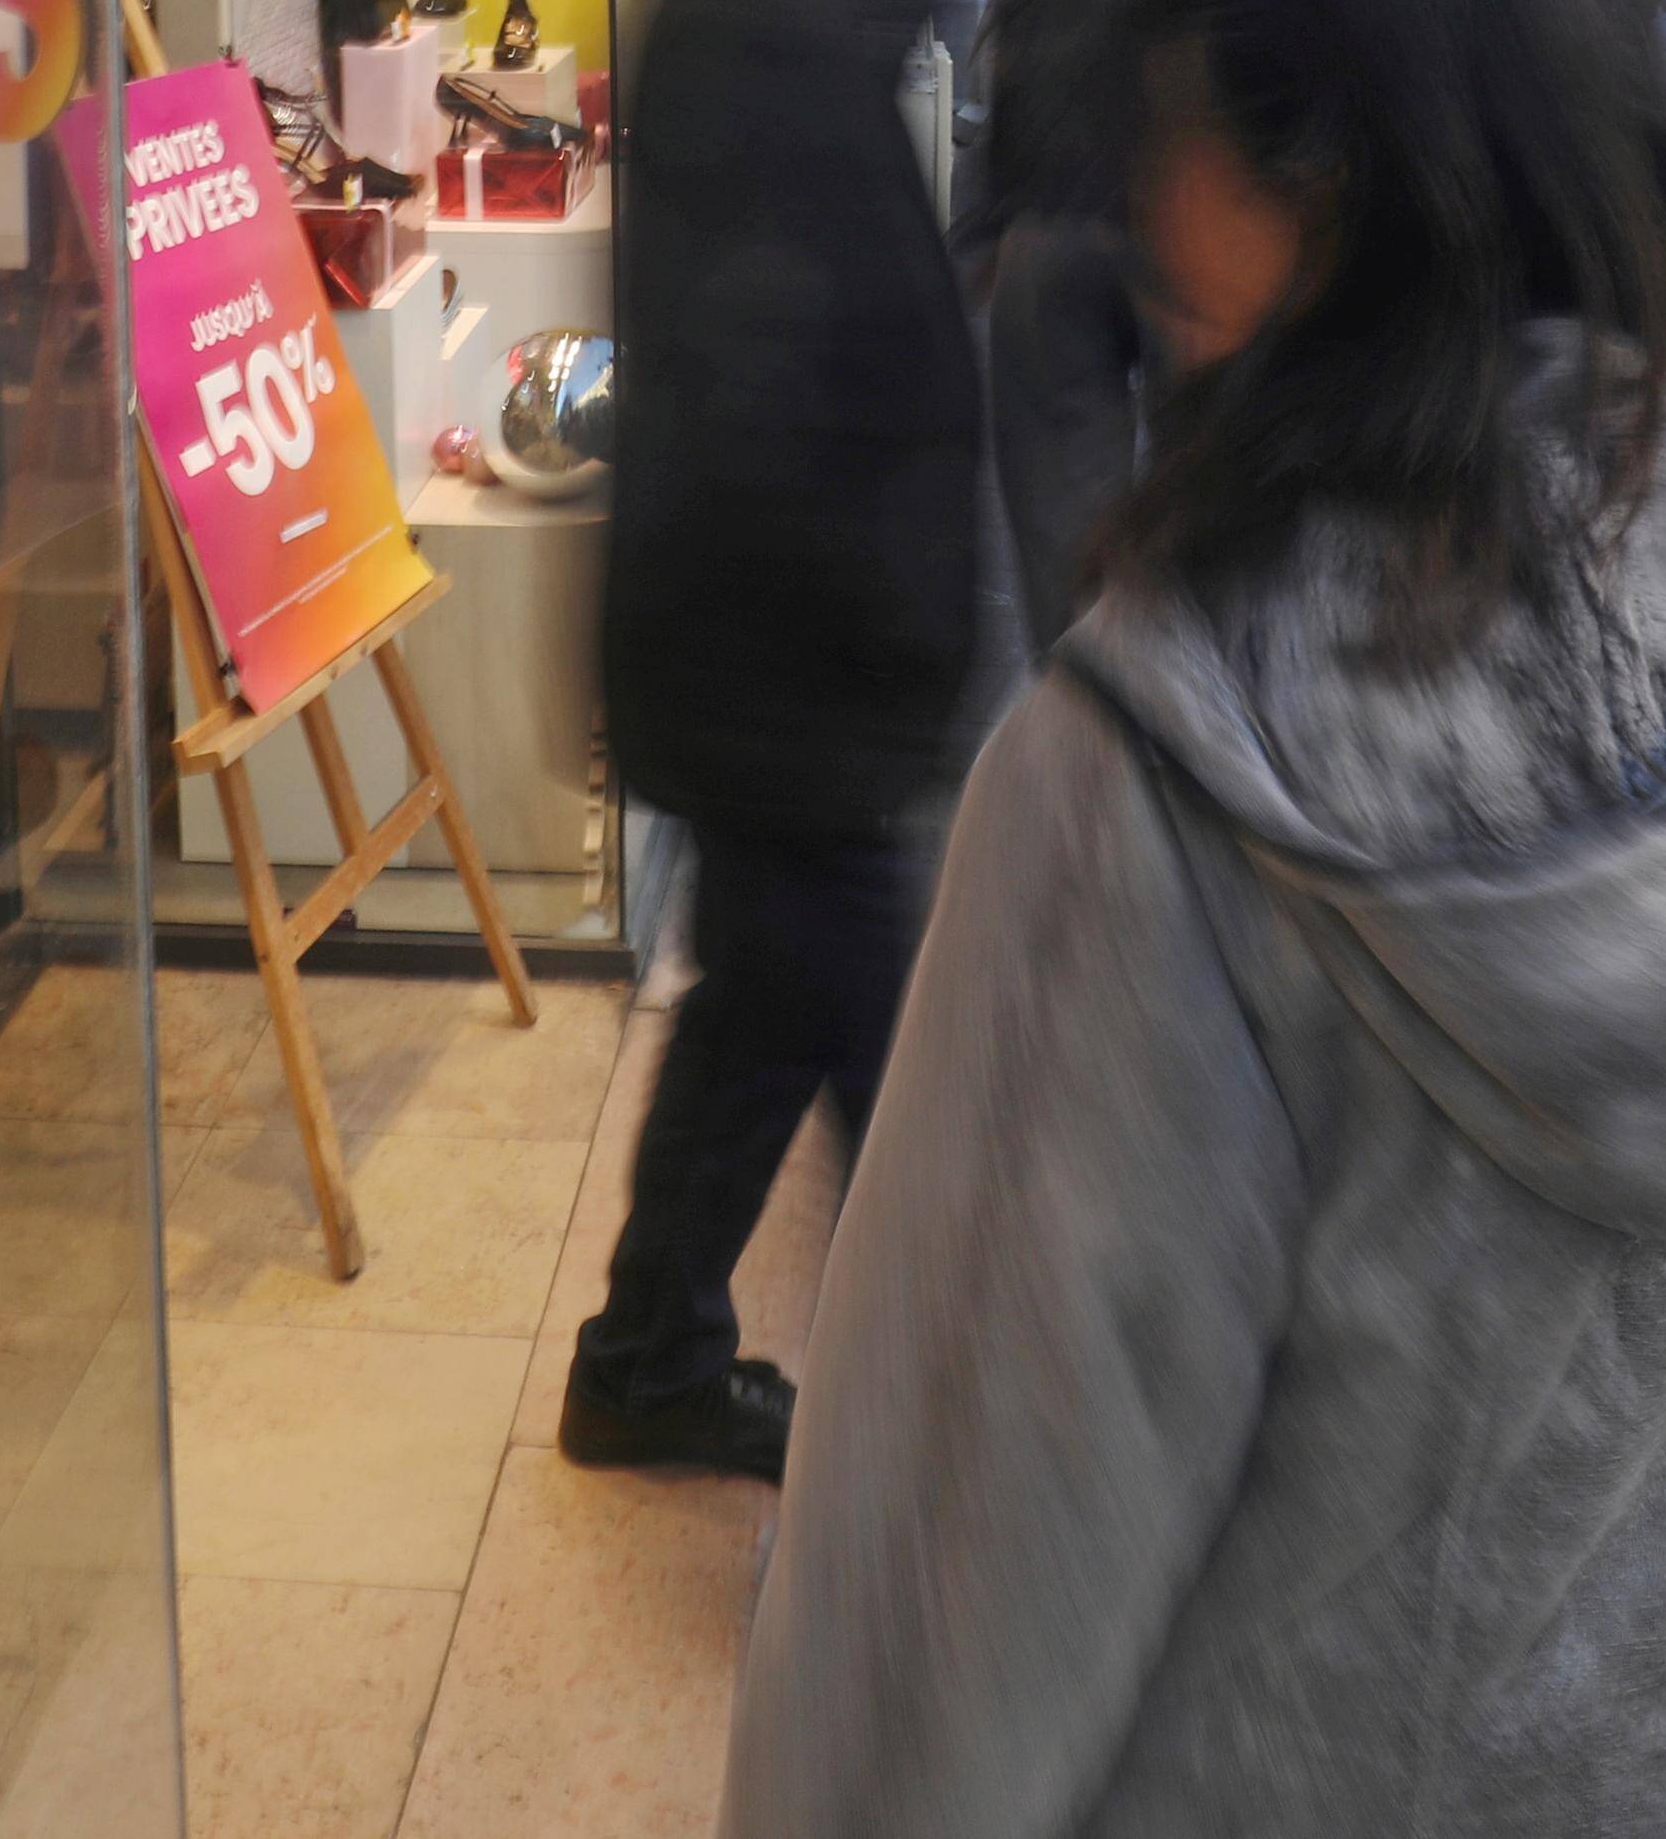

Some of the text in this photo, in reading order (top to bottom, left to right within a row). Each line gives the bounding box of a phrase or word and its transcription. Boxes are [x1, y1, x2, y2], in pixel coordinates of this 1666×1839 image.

[124, 119, 226, 187] VENTES
[126, 163, 261, 261] PRIVEES
[179, 316, 336, 497] -50%
